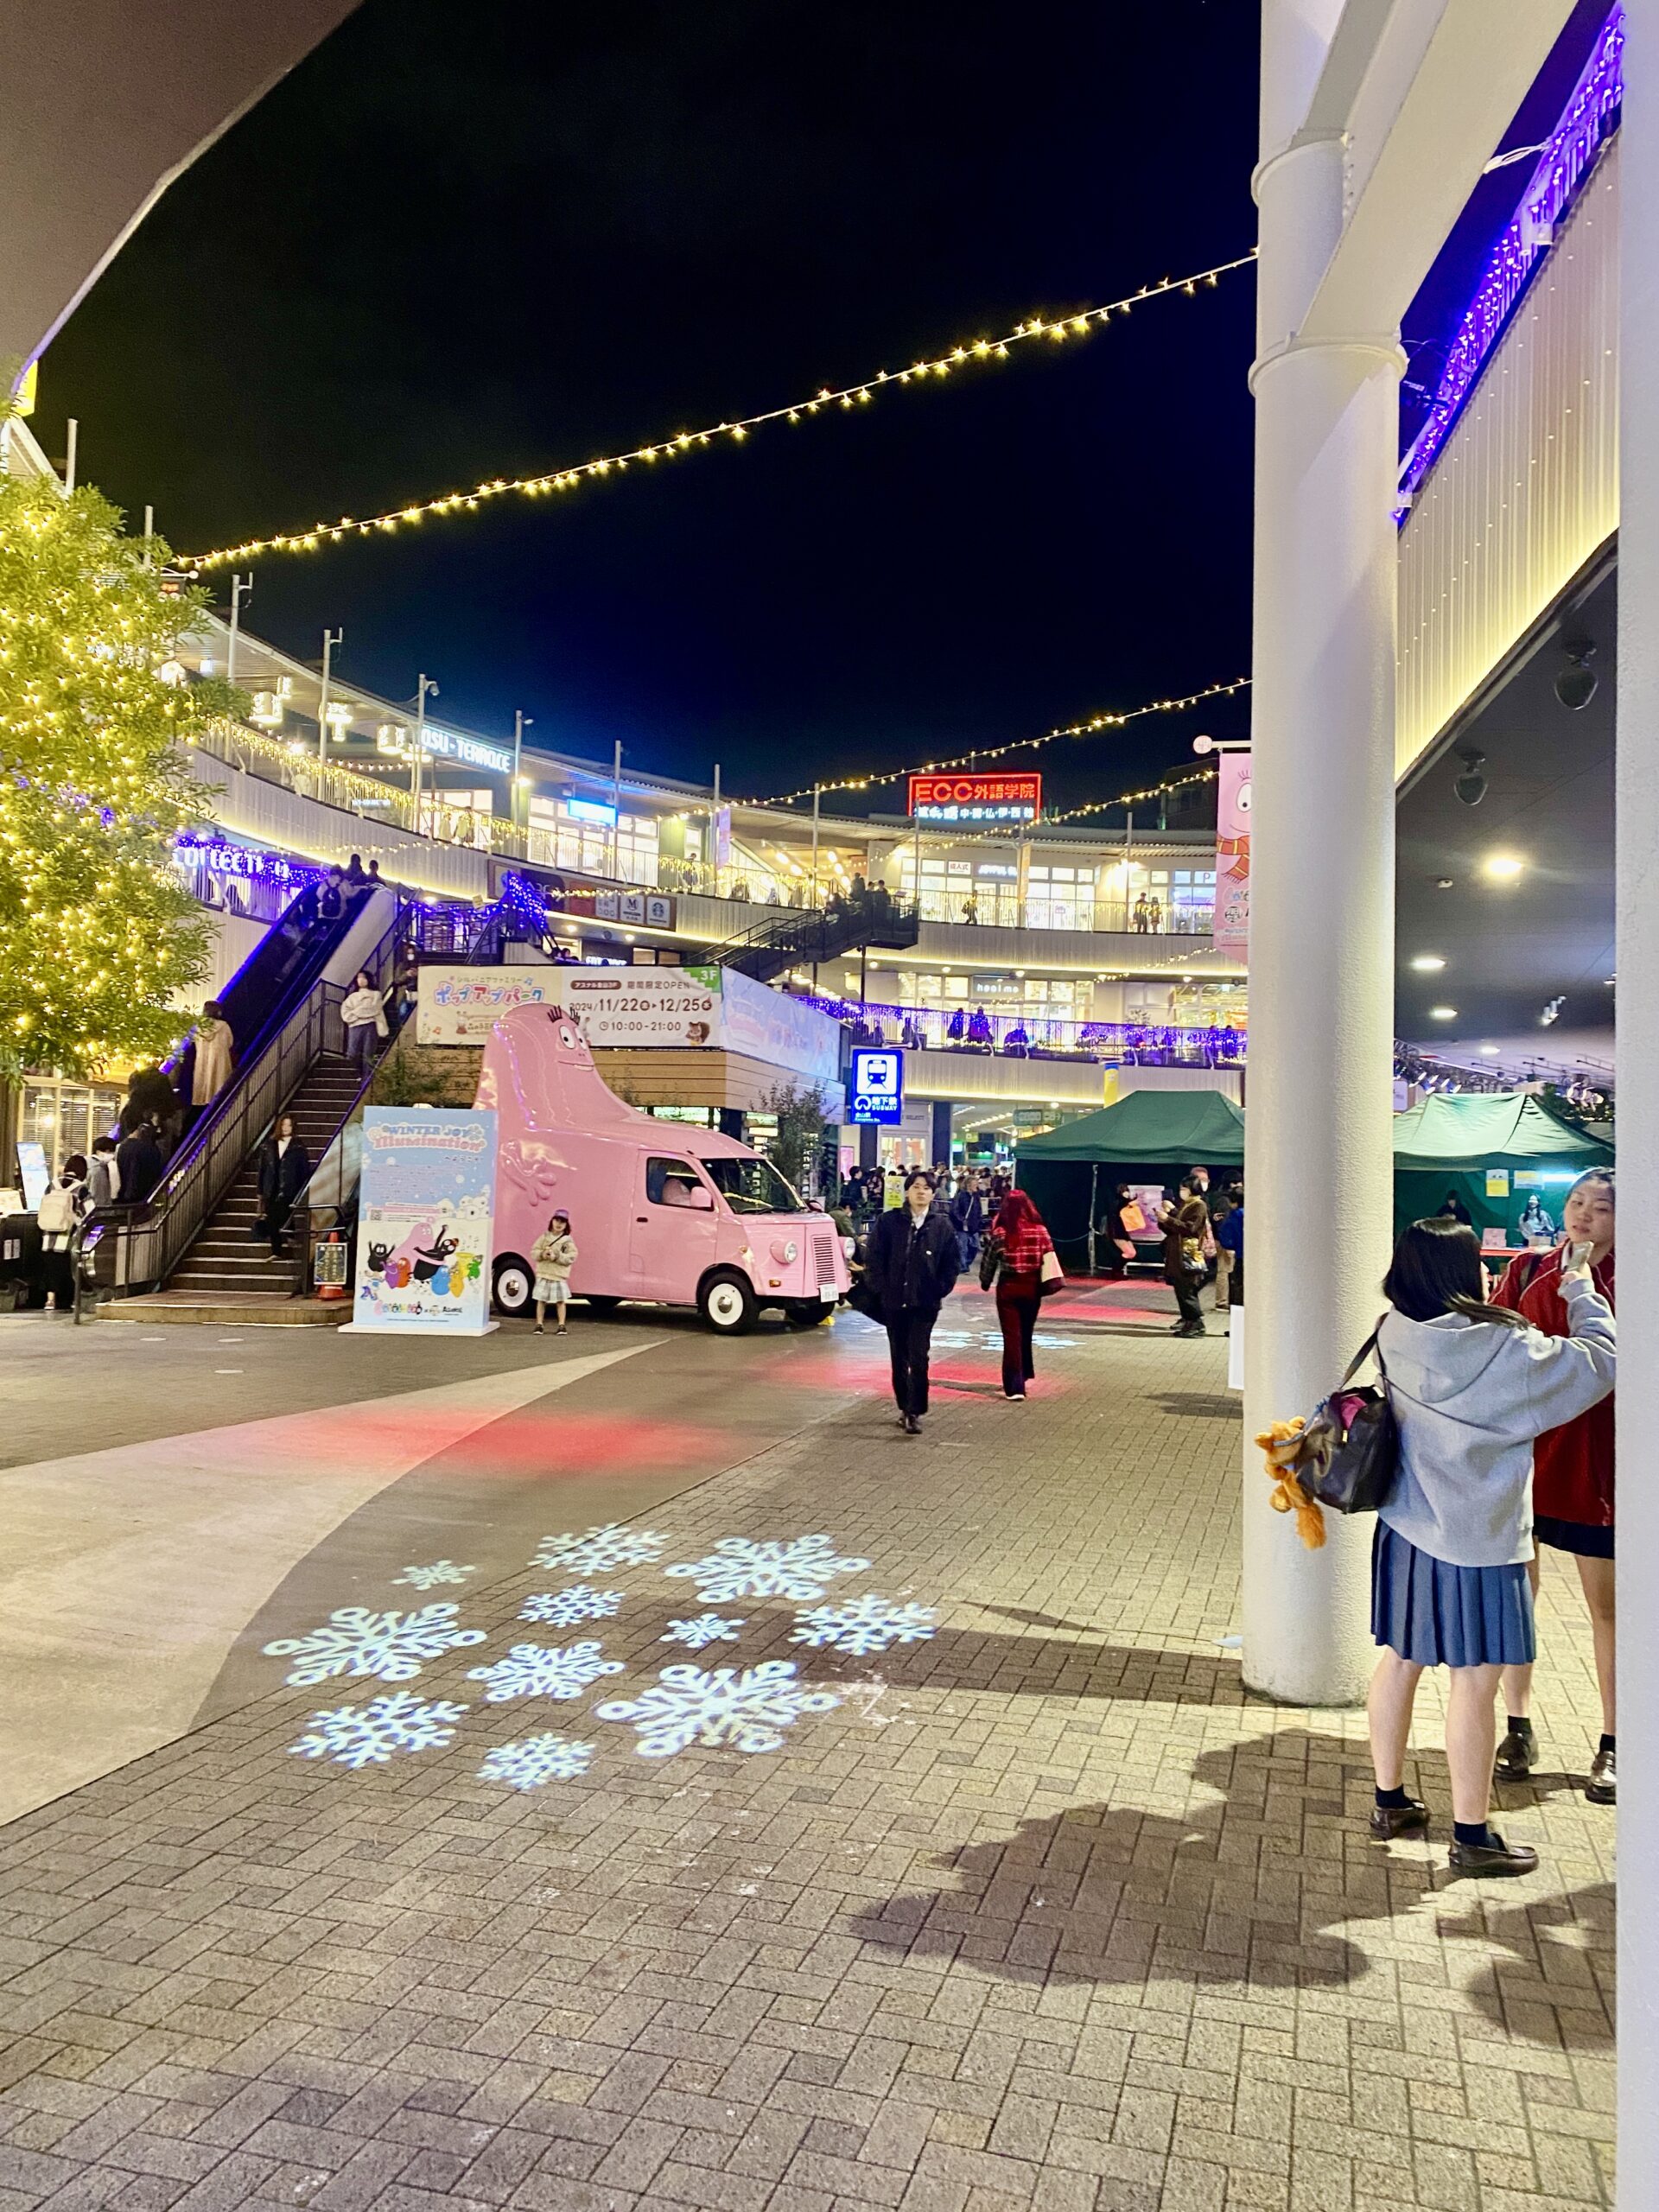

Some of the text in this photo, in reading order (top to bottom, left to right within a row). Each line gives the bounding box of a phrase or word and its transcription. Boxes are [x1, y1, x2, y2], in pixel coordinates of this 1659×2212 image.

[700, 969, 718, 980] 3F
[627, 981, 691, 989] 期間限定OPEN
[435, 983, 543, 1005] ポップアップパーク
[389, 1126, 471, 1138] WINTER JOY
[375, 1135, 482, 1153] Illumination
